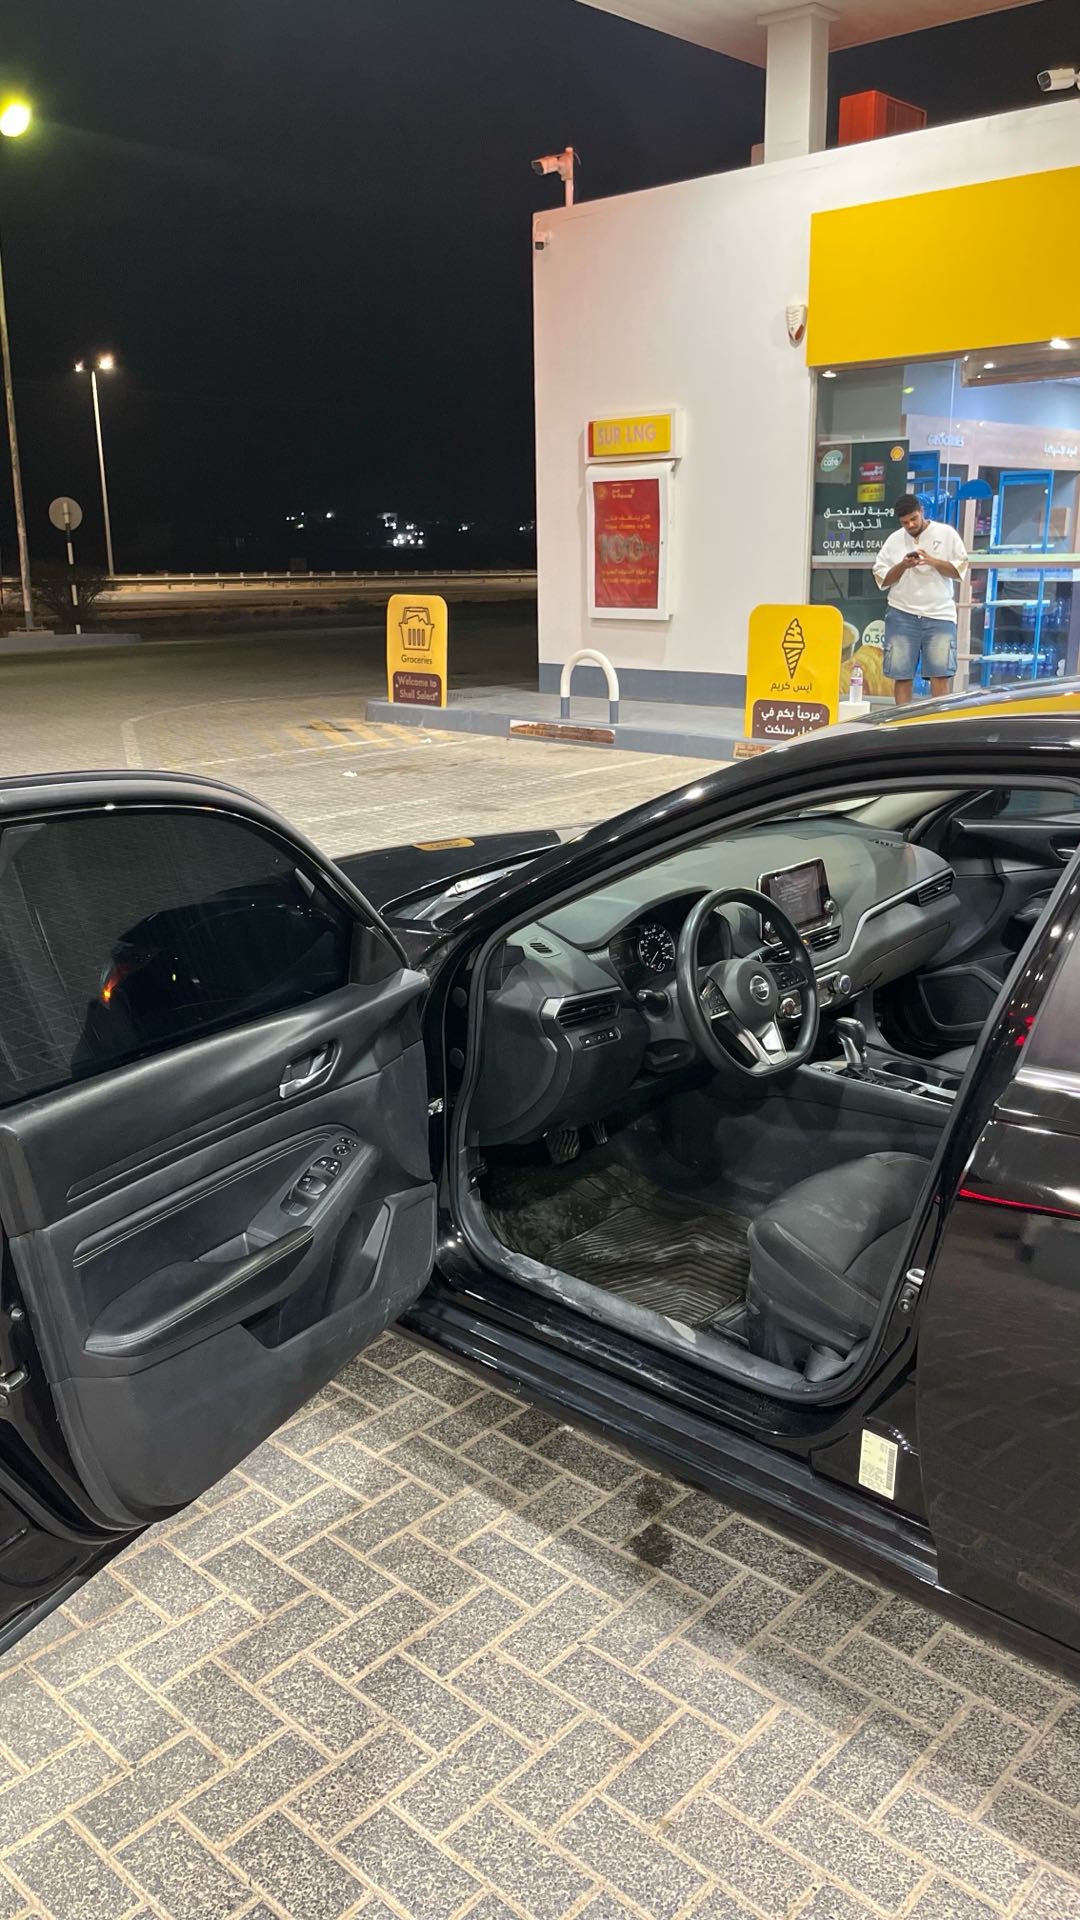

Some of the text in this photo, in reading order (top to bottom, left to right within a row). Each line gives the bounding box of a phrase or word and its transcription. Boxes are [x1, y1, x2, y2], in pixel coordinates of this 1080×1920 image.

[598, 422, 656, 446] SUR LNG
[837, 518, 882, 532] التجربة
[822, 540, 841, 549] OUR
[843, 540, 865, 549] MEAL
[401, 654, 433, 665] Groceries
[397, 675, 437, 688] Welcome to
[770, 681, 791, 691] كريم
[400, 689, 436, 701] Shell Select
[761, 706, 775, 721] في
[776, 708, 795, 721] بكم
[764, 724, 795, 736] سلكت
